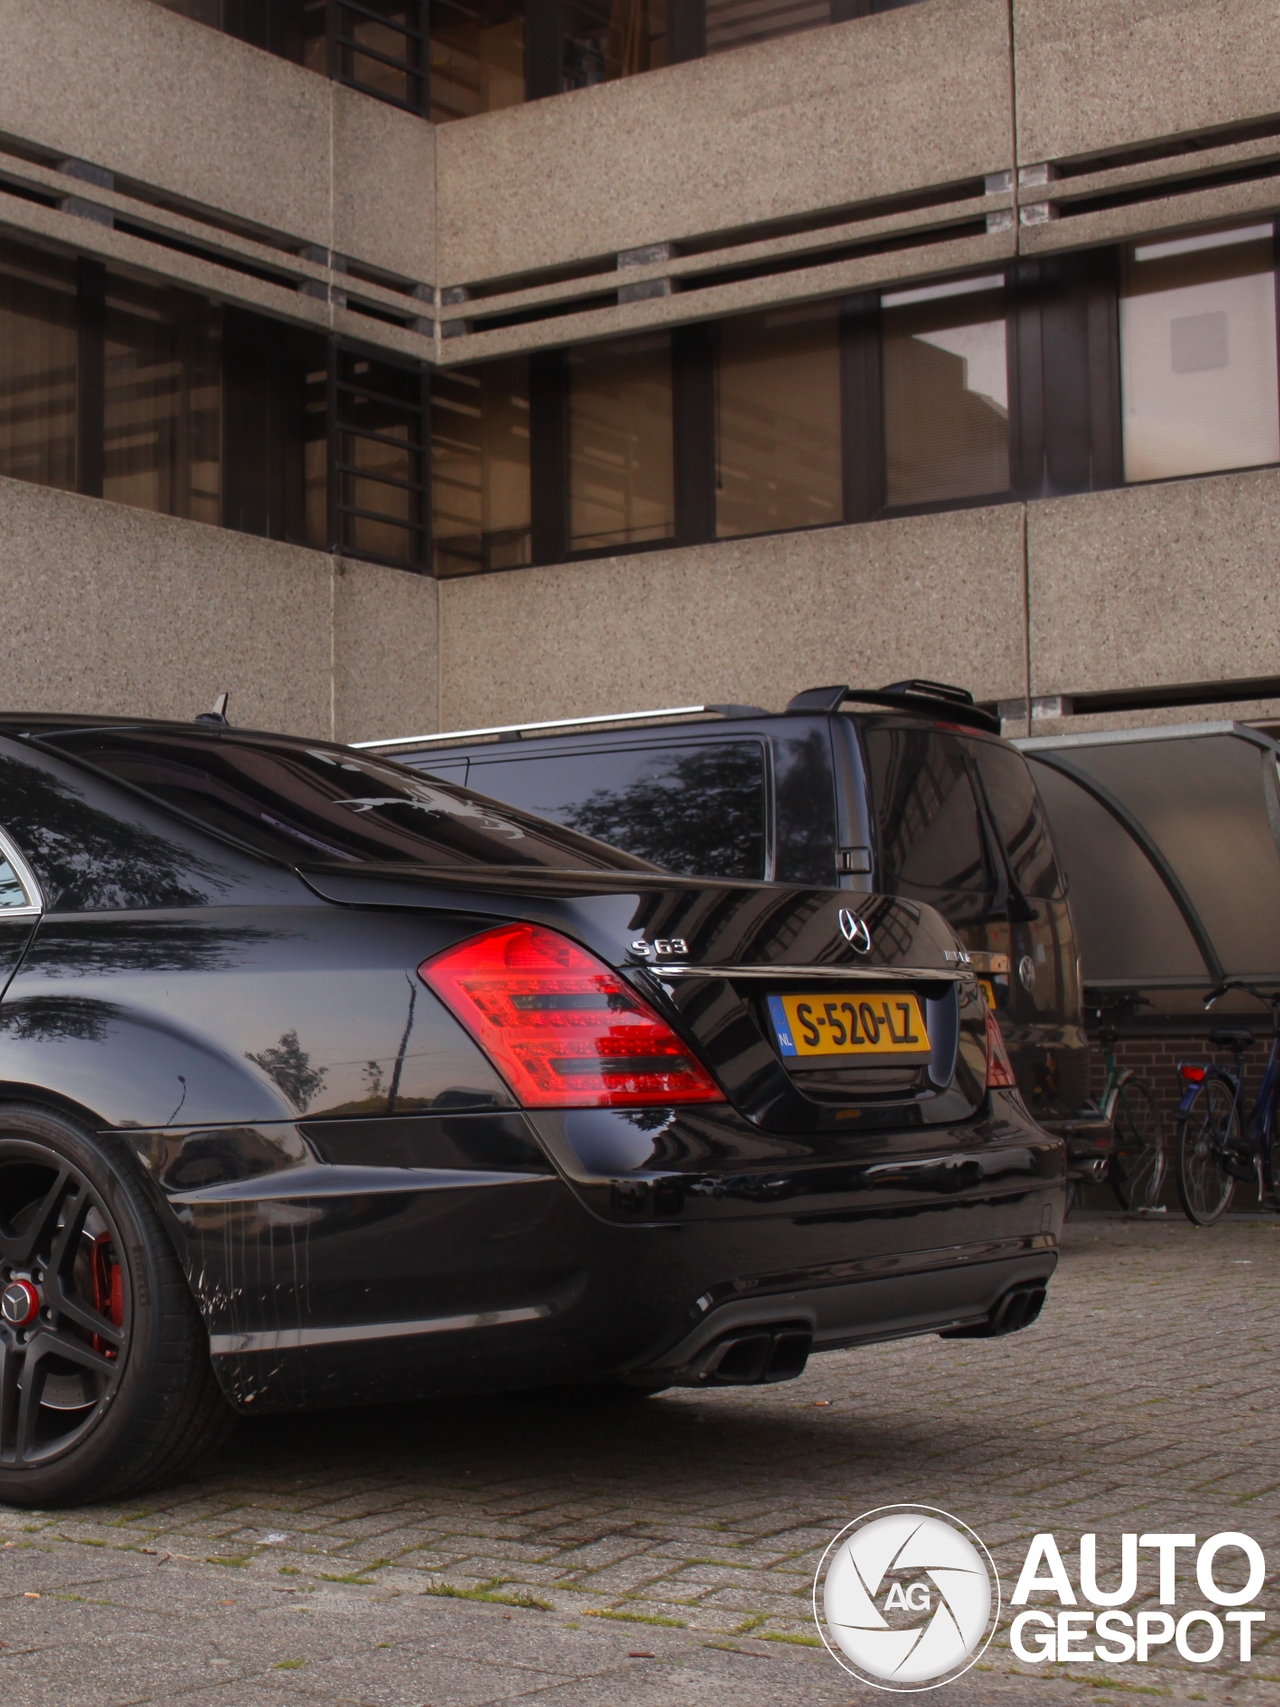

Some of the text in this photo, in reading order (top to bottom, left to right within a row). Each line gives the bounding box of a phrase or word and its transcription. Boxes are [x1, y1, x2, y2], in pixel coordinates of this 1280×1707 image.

[631, 938, 689, 956] S 63
[796, 1001, 919, 1047] S-520-LZ
[778, 1032, 793, 1047] NL
